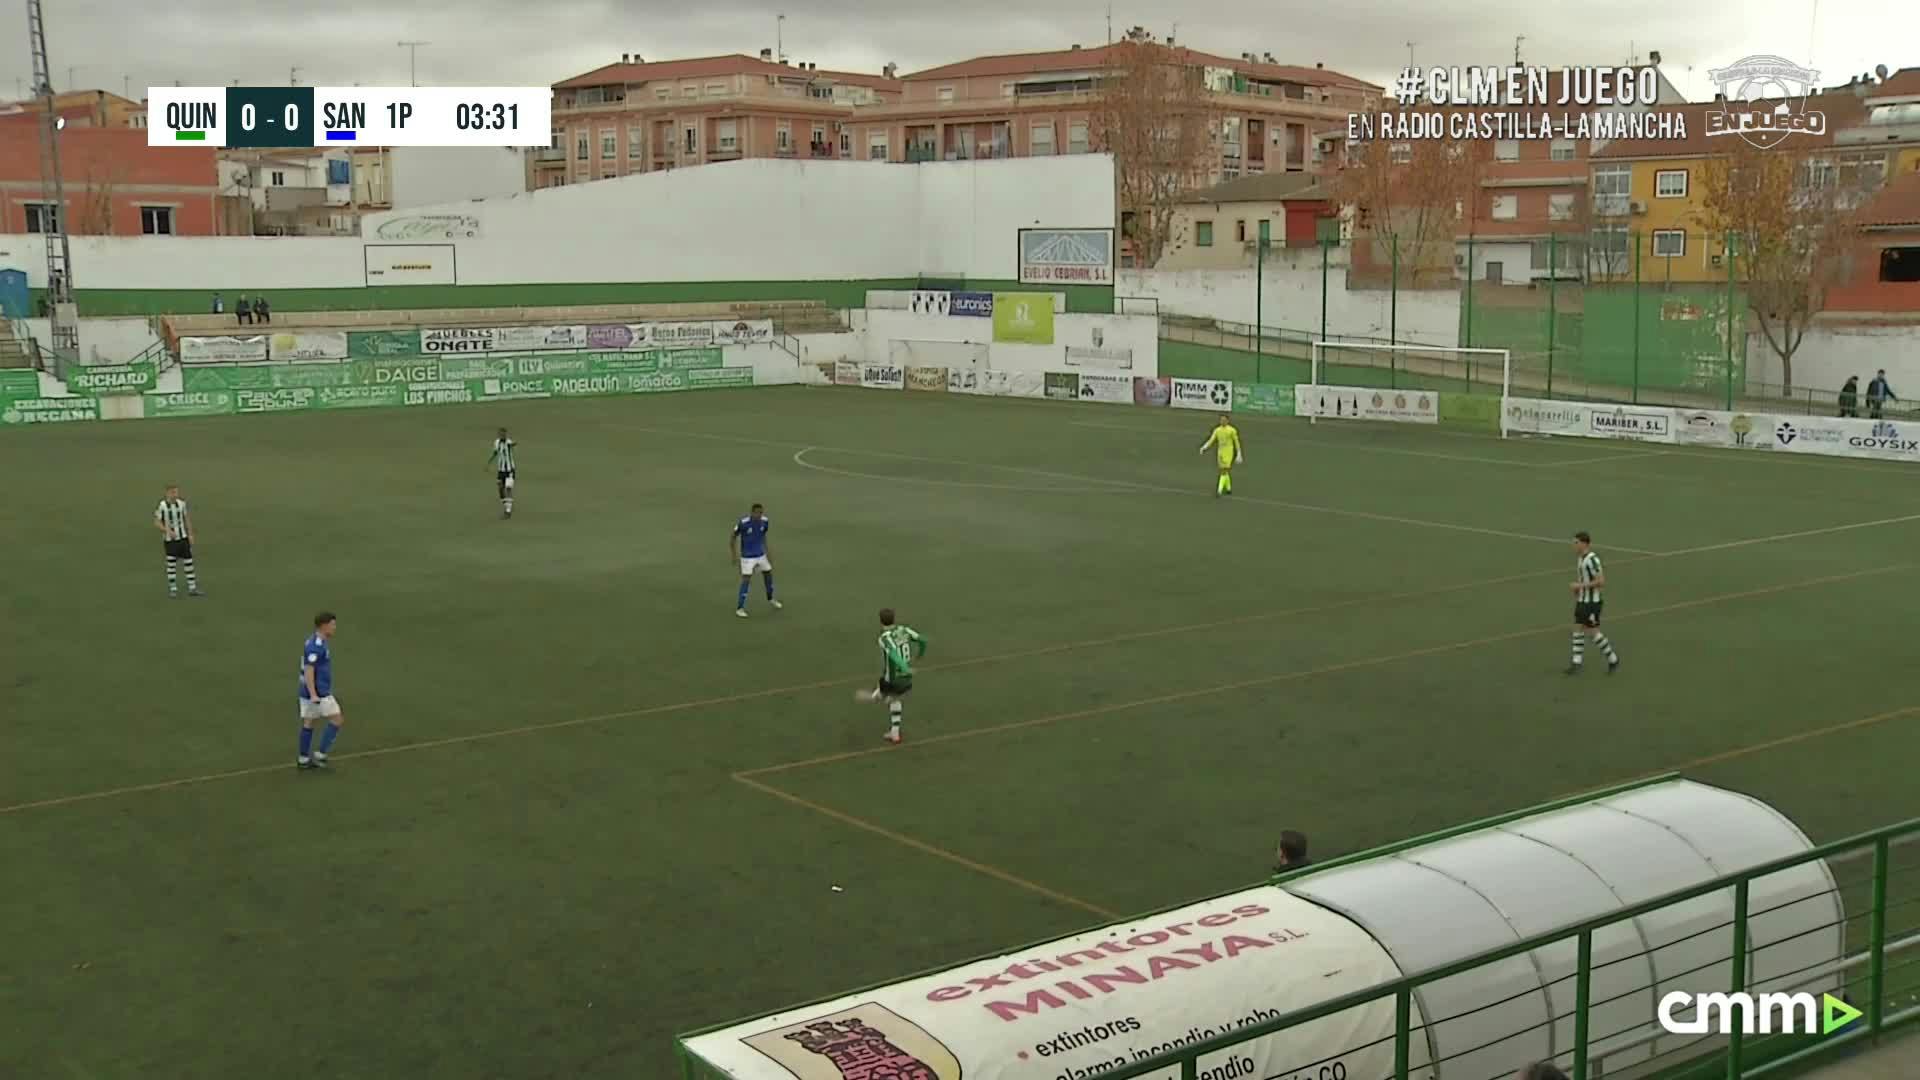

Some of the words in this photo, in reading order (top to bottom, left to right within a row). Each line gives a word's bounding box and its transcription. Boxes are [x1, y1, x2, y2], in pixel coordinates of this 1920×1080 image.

[1023, 267, 1051, 279] EVELIO
[76, 372, 149, 388] RICHARD
[375, 366, 438, 383] DAIGE
[502, 380, 545, 393] PONCE
[404, 390, 424, 405] LOS
[1849, 436, 1919, 451] GOYSIX
[926, 903, 1271, 1003] extintores
[983, 934, 1276, 1023] MINAYA
[1268, 928, 1311, 944] S.L.
[1034, 1014, 1142, 1058] extintores
